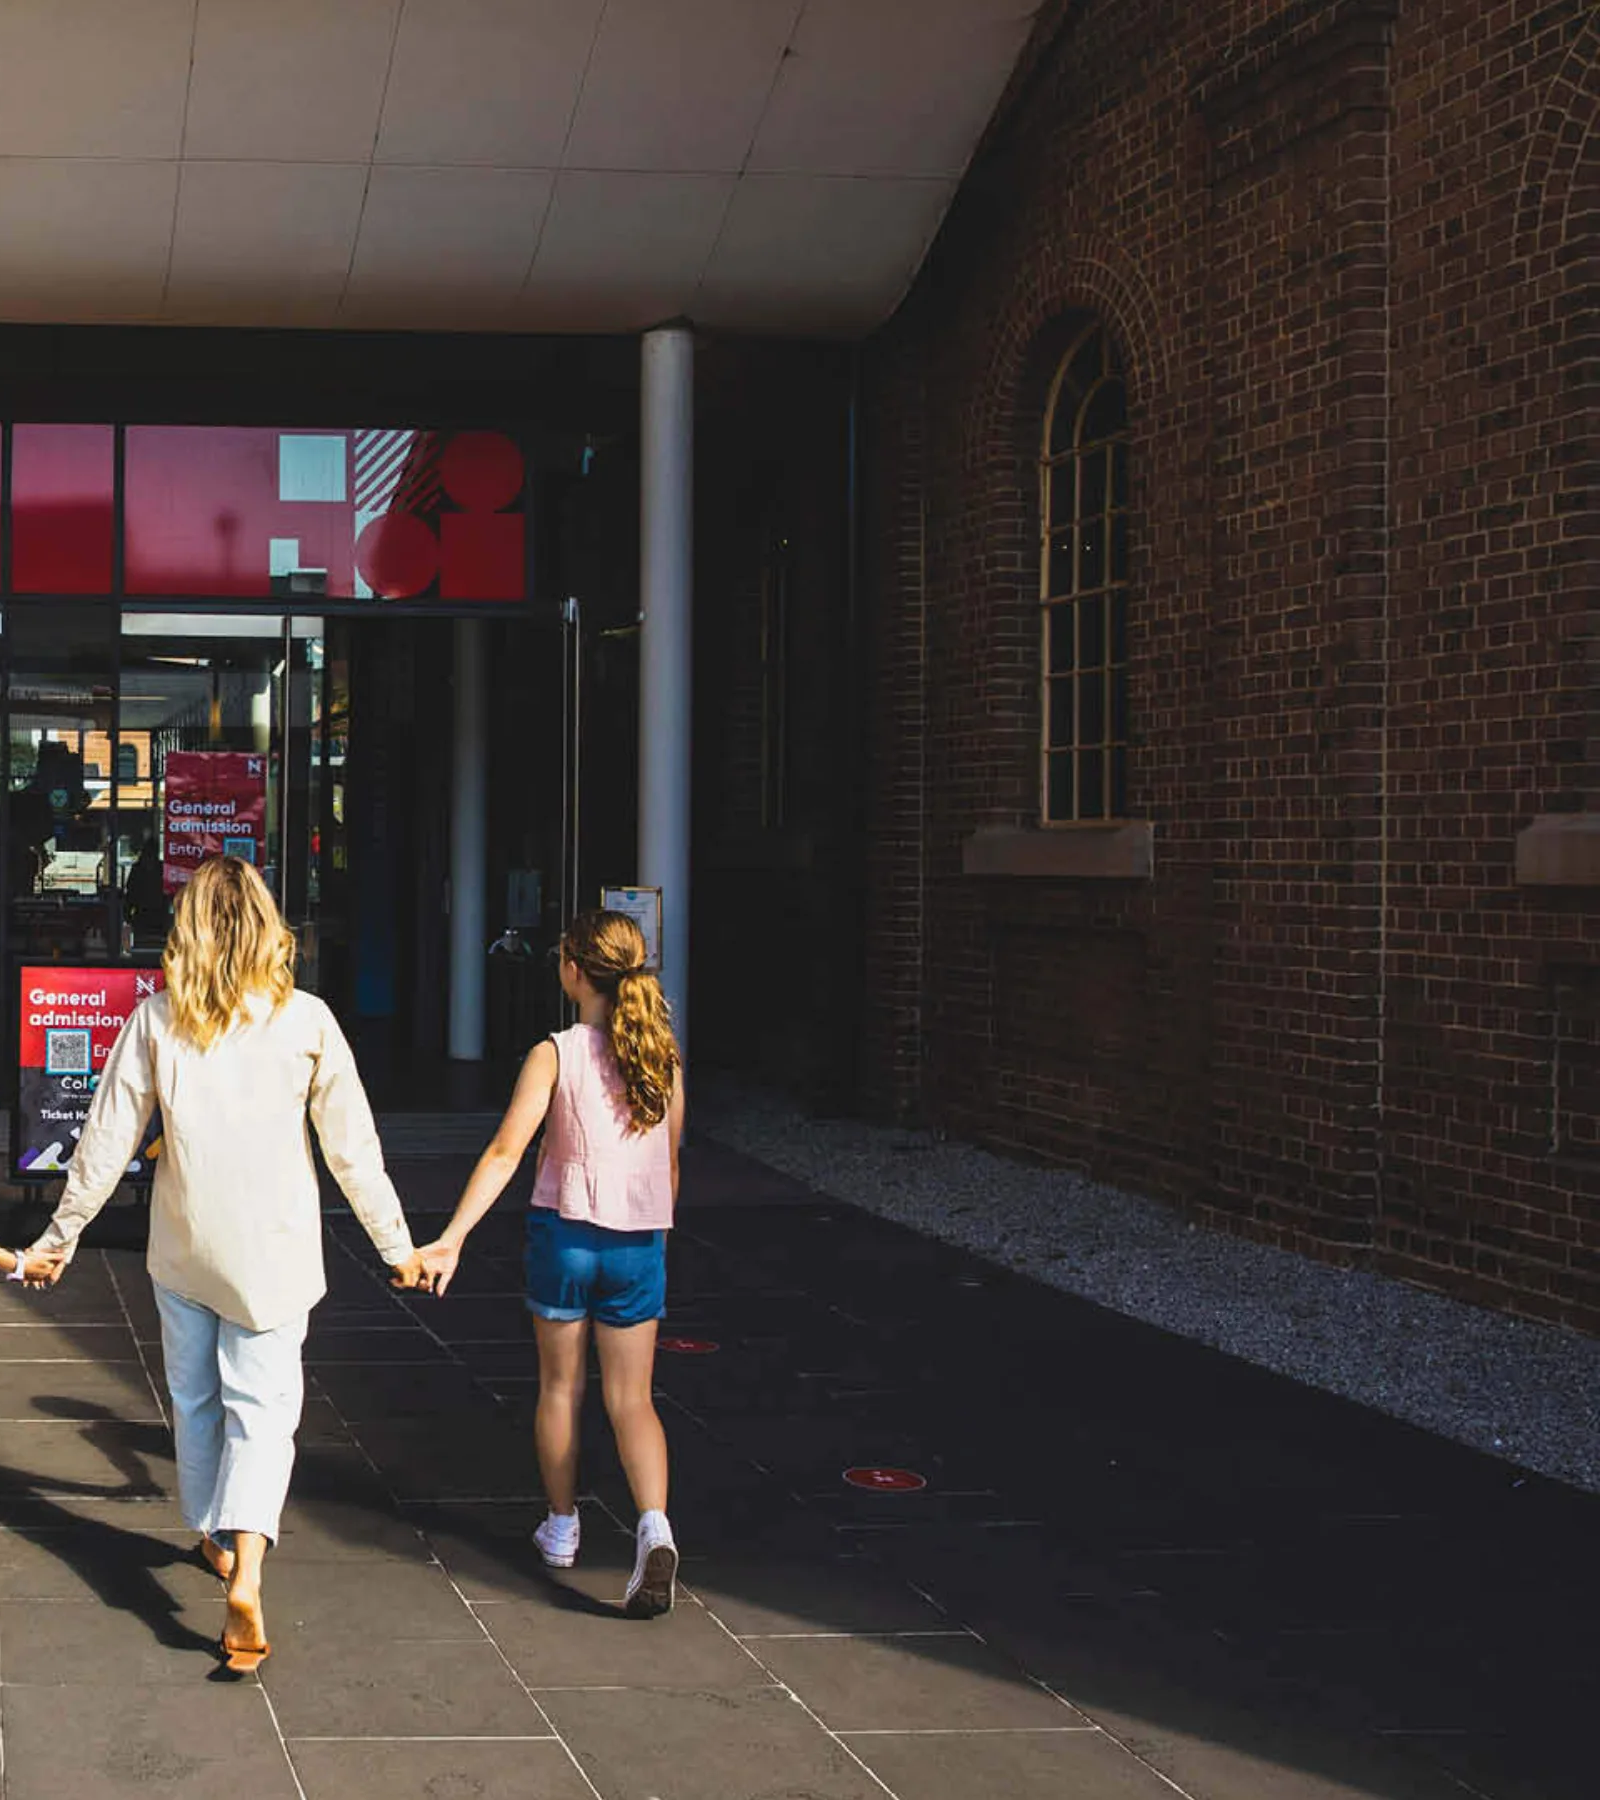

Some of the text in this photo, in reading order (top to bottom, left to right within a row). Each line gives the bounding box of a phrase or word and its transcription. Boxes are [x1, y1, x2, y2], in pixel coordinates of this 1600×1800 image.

[169, 799, 236, 815] General
[169, 818, 252, 834] admission
[169, 842, 206, 858] Entry
[29, 989, 106, 1006] General
[29, 1011, 125, 1027] admission
[41, 1109, 73, 1119] Ticket
